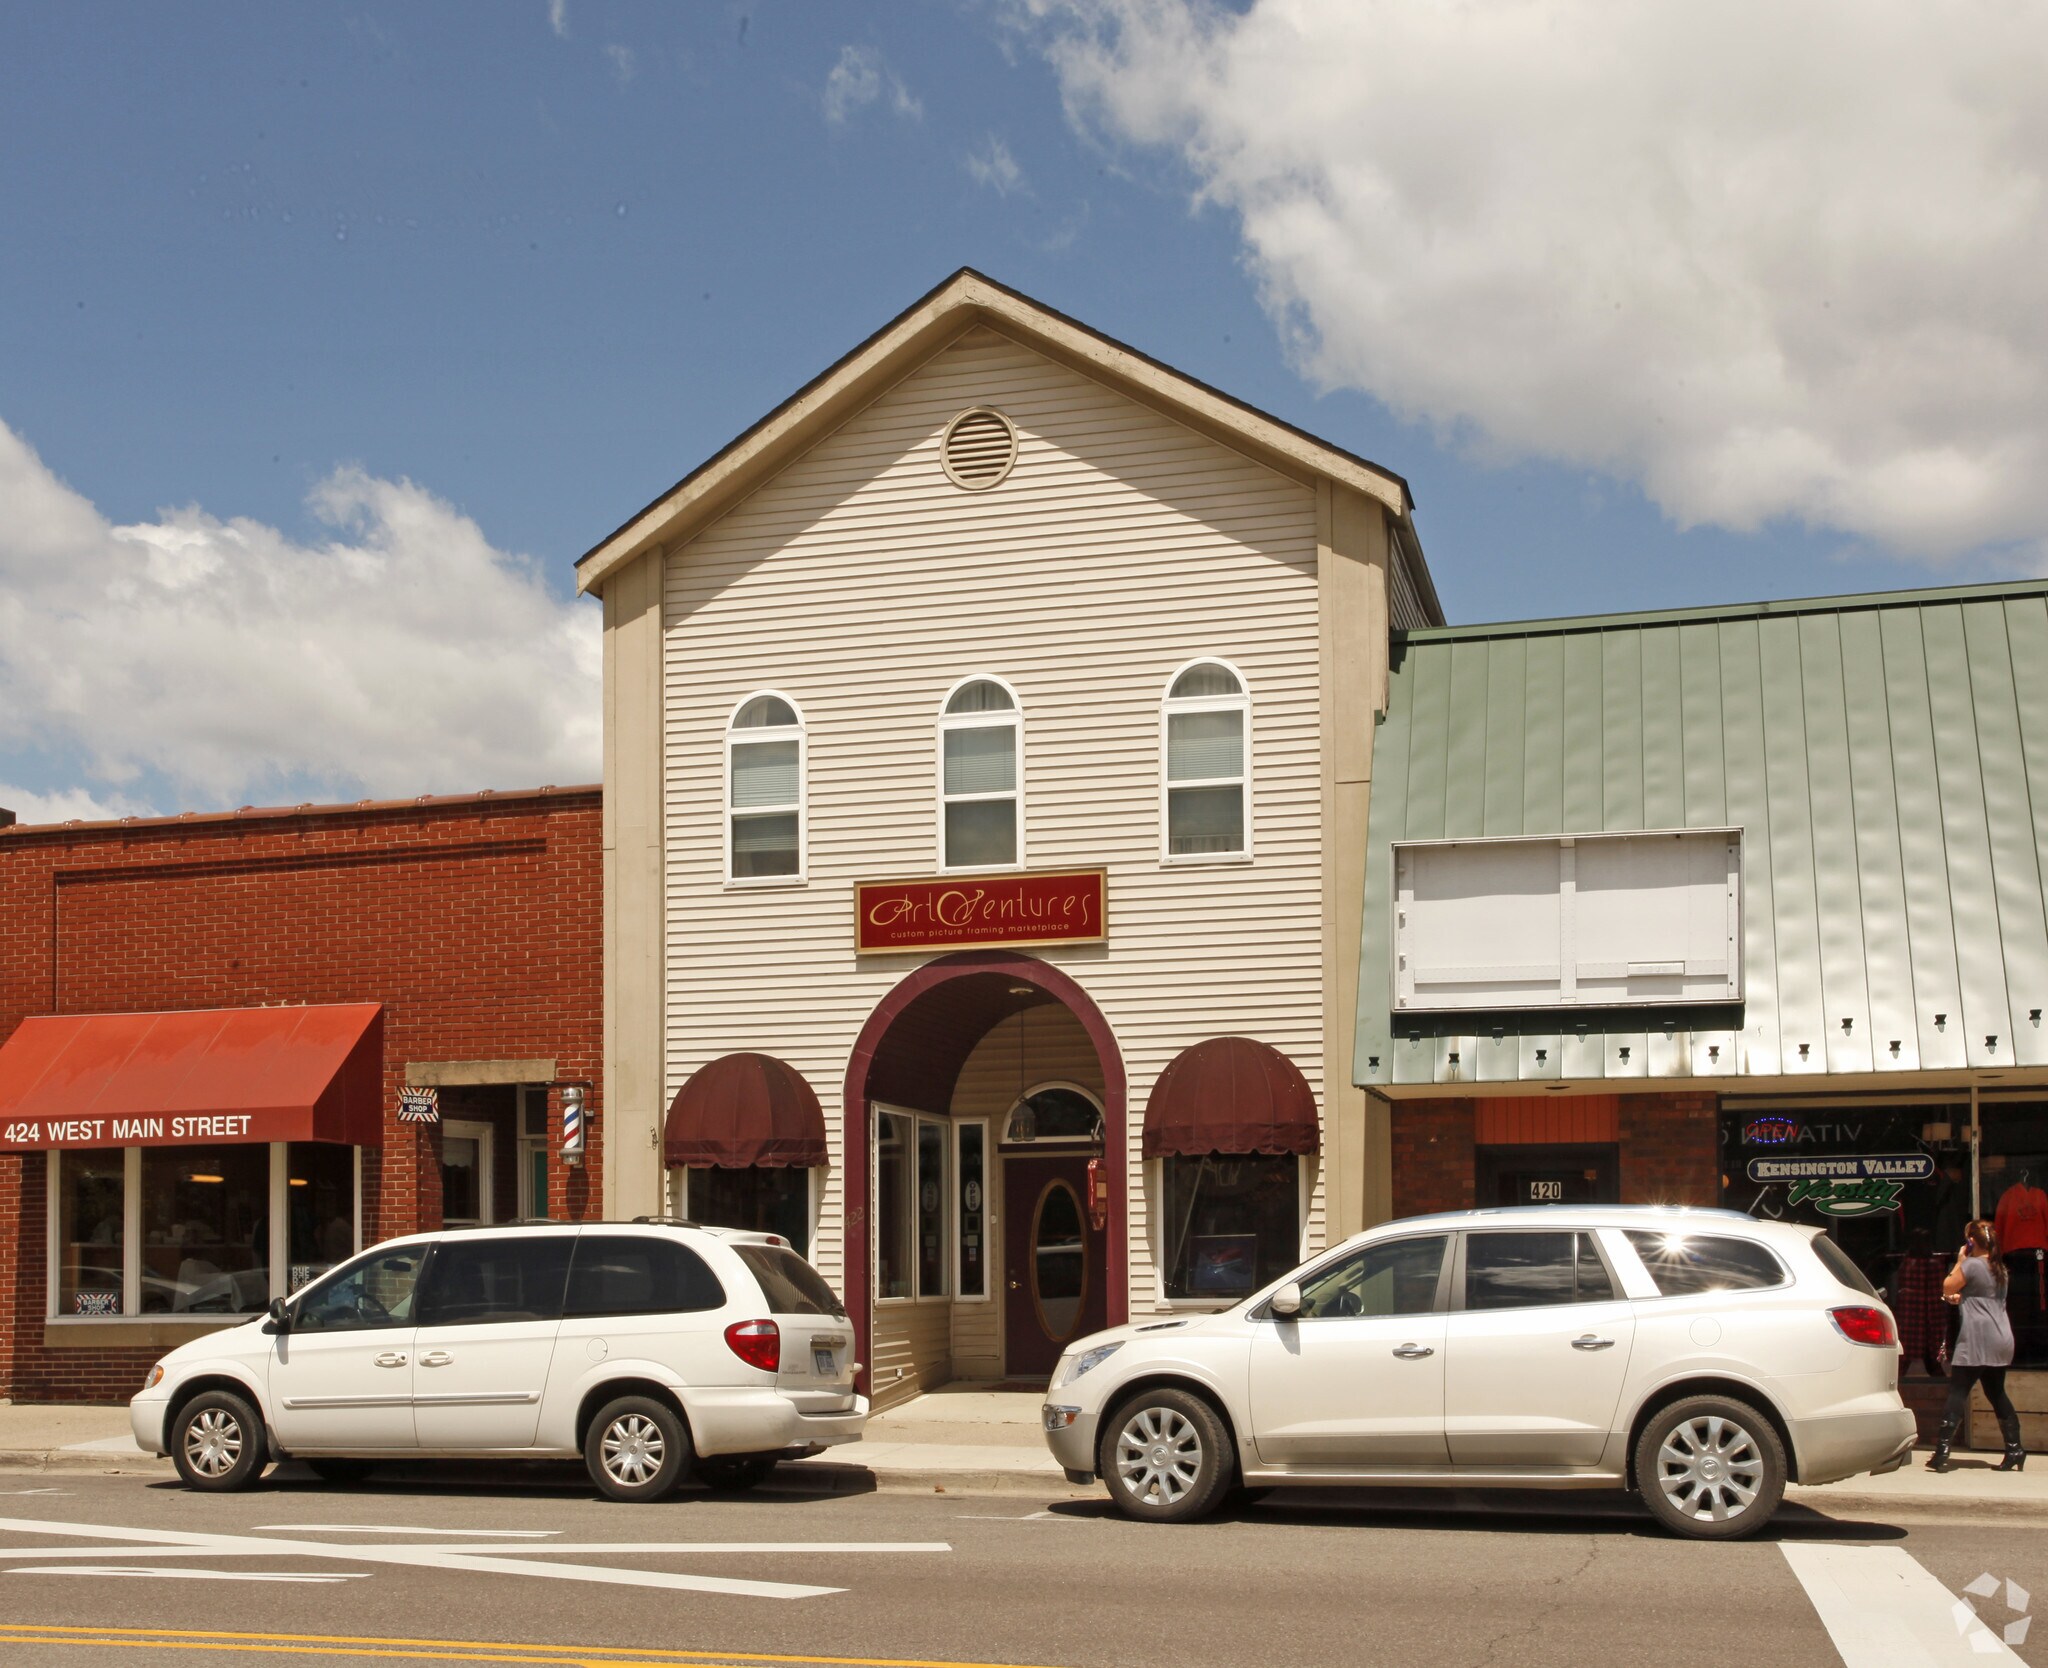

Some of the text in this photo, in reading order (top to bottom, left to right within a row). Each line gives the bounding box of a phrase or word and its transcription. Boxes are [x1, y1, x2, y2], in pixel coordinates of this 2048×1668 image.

[869, 888, 1091, 926] ArtVentures
[891, 923, 1070, 939] custom picture framing marketplace
[403, 1096, 432, 1105] BARBER
[408, 1104, 428, 1112] SHOP
[4, 1115, 251, 1143] 424 WEST MAIN STREET
[1746, 1123, 1798, 1138] OPEN
[1757, 1161, 1858, 1177] KENSINGTON
[1863, 1159, 1926, 1175] VALLEY
[969, 1183, 977, 1209] OPEN
[1532, 1182, 1560, 1199] 420
[1788, 1178, 1904, 1216] Varsity
